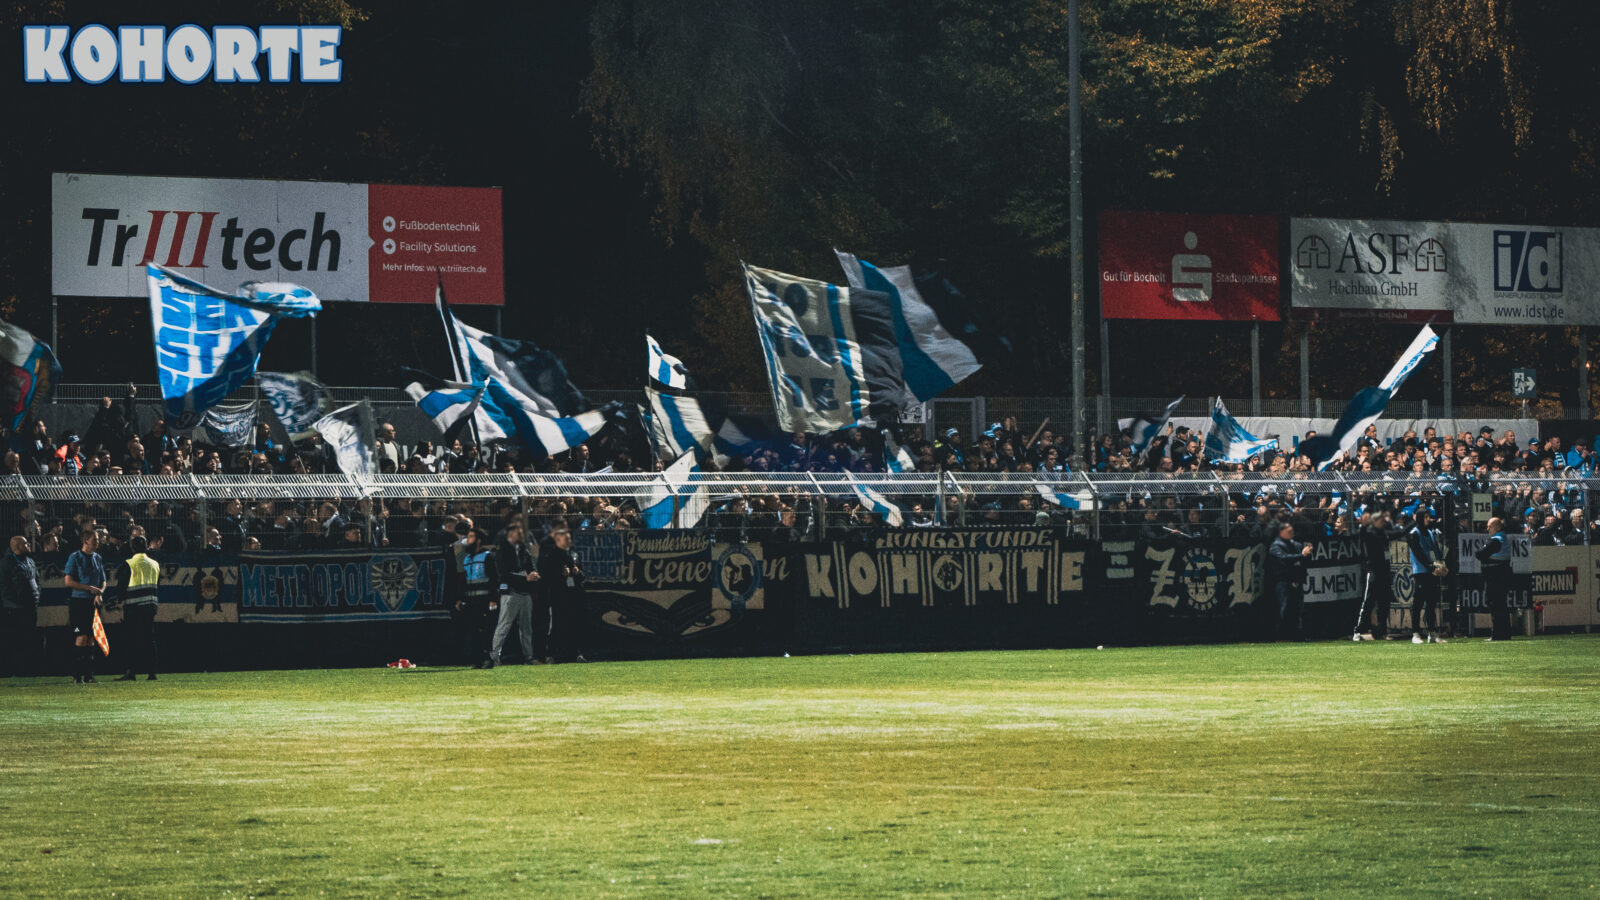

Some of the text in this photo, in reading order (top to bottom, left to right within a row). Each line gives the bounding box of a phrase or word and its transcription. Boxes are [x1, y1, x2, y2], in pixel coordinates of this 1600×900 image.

[399, 221, 481, 232] Fußbodentechnik
[400, 241, 477, 254] Facility Solutions
[1335, 231, 1409, 275] ASF
[382, 263, 403, 272] Mehr
[404, 264, 425, 272] Infos:
[1103, 271, 1167, 283] Gut für Bocholt
[1215, 272, 1278, 284] Stadtsparkasse
[1328, 279, 1418, 297] Hochbau GmbH
[1494, 304, 1565, 319] www.idst.de
[1475, 502, 1491, 513] T16
[626, 531, 710, 555] Freundeskreis
[239, 560, 376, 608] METROPOL
[416, 558, 446, 606] 47
